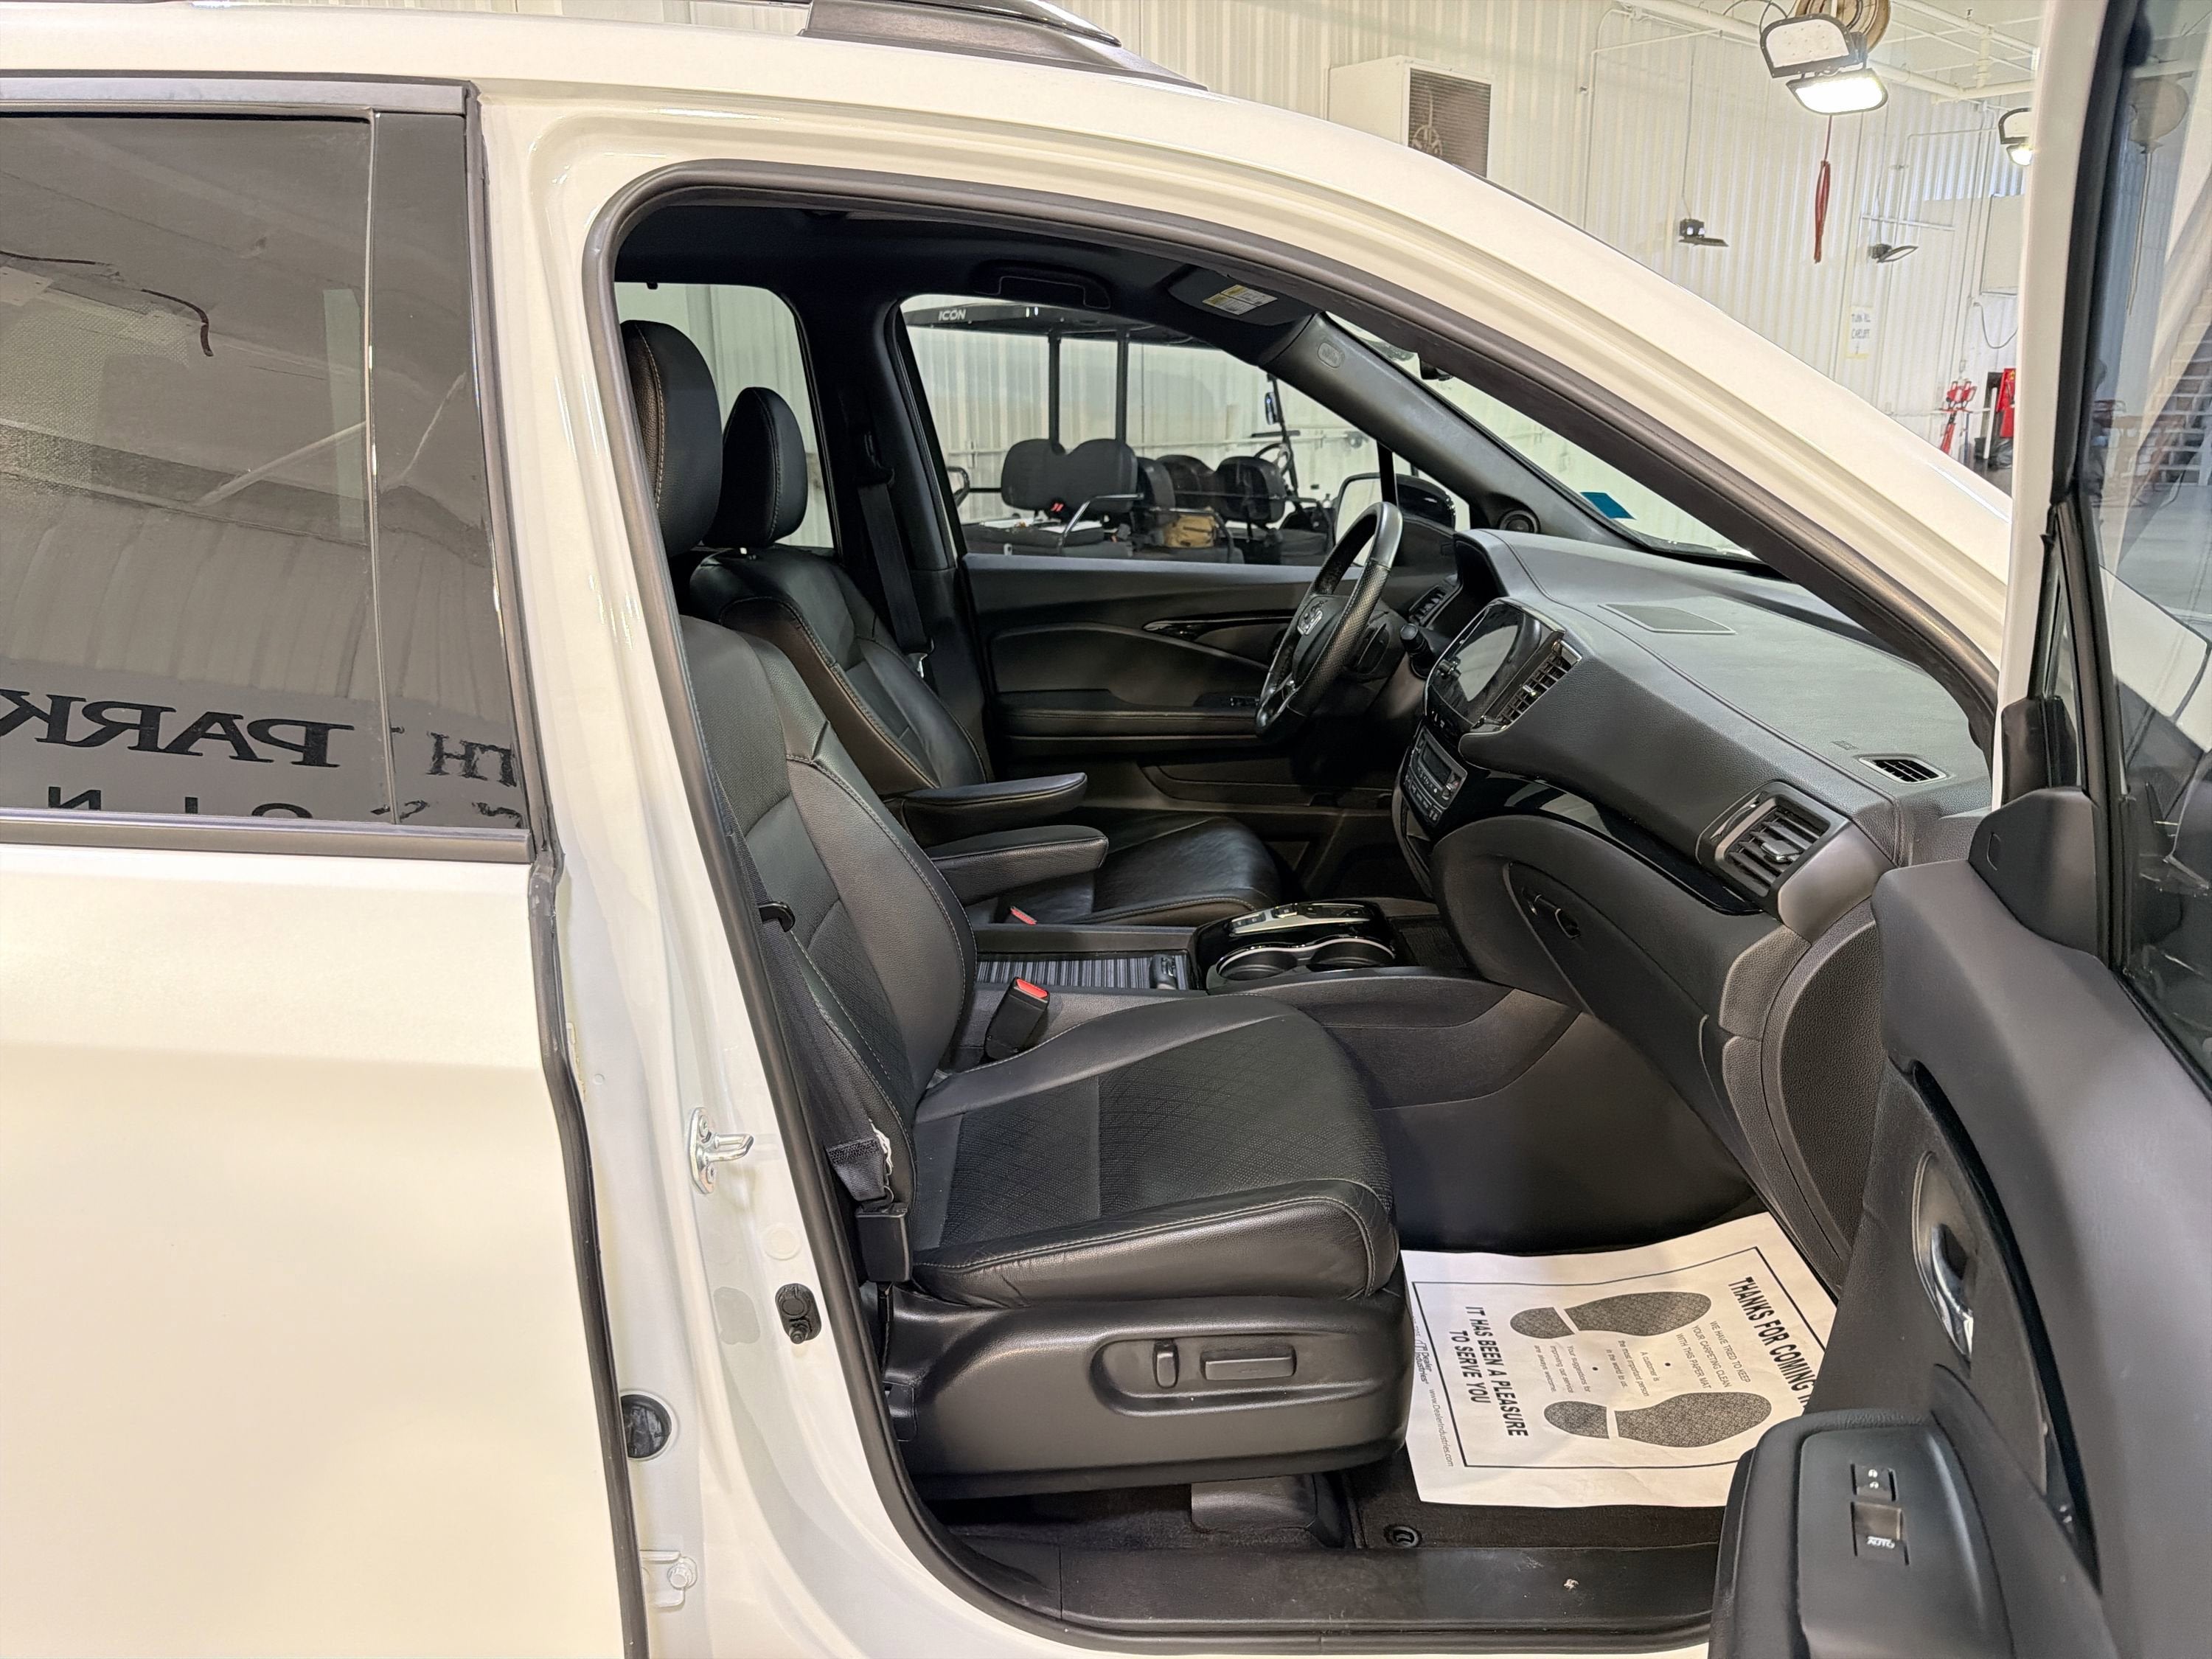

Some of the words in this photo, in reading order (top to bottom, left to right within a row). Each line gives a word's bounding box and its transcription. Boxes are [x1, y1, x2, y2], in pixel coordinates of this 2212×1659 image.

[938, 309, 967, 321] ICON
[1728, 1276, 1775, 1321] THANKS
[1465, 1306, 1486, 1316] IT
[1470, 1318, 1493, 1337] HAS
[1710, 1321, 1720, 1331] WE
[1753, 1319, 1790, 1346] FOR
[1449, 1330, 1470, 1343] TO
[1714, 1330, 1728, 1345] HAVE
[1478, 1340, 1504, 1366] BEEN
[1567, 1346, 1576, 1356] Your
[1676, 1333, 1688, 1347] WITH
[1683, 1346, 1694, 1360] THIS
[1689, 1359, 1705, 1377] PAPER
[1699, 1377, 1711, 1388] MAT
[1692, 1325, 1705, 1340] YOUR
[1700, 1340, 1721, 1370] CARPETING
[1716, 1369, 1732, 1388] CLEAN
[1723, 1345, 1737, 1360] TRIED
[1422, 1352, 1432, 1372] Dealer
[1454, 1346, 1483, 1378] SERVE
[1537, 1354, 1548, 1370] always
[1550, 1346, 1563, 1367] improving
[1563, 1377, 1573, 1393] service
[1571, 1357, 1587, 1385] suggestions
[1612, 1362, 1624, 1374] world
[1643, 1357, 1658, 1376] customer
[1732, 1360, 1742, 1369] TO
[1770, 1344, 1816, 1391] COMING
[1487, 1368, 1507, 1377] A
[1622, 1348, 1632, 1359] most
[1627, 1360, 1643, 1380] important
[1635, 1381, 1649, 1397] person
[1736, 1368, 1751, 1383] KEEP
[1466, 1382, 1492, 1404] YOU
[1491, 1380, 1529, 1436] PLEASURE
[1429, 1388, 1454, 1467] www.DealerIndustries.com
[1867, 1537, 1895, 1548] AUTO
